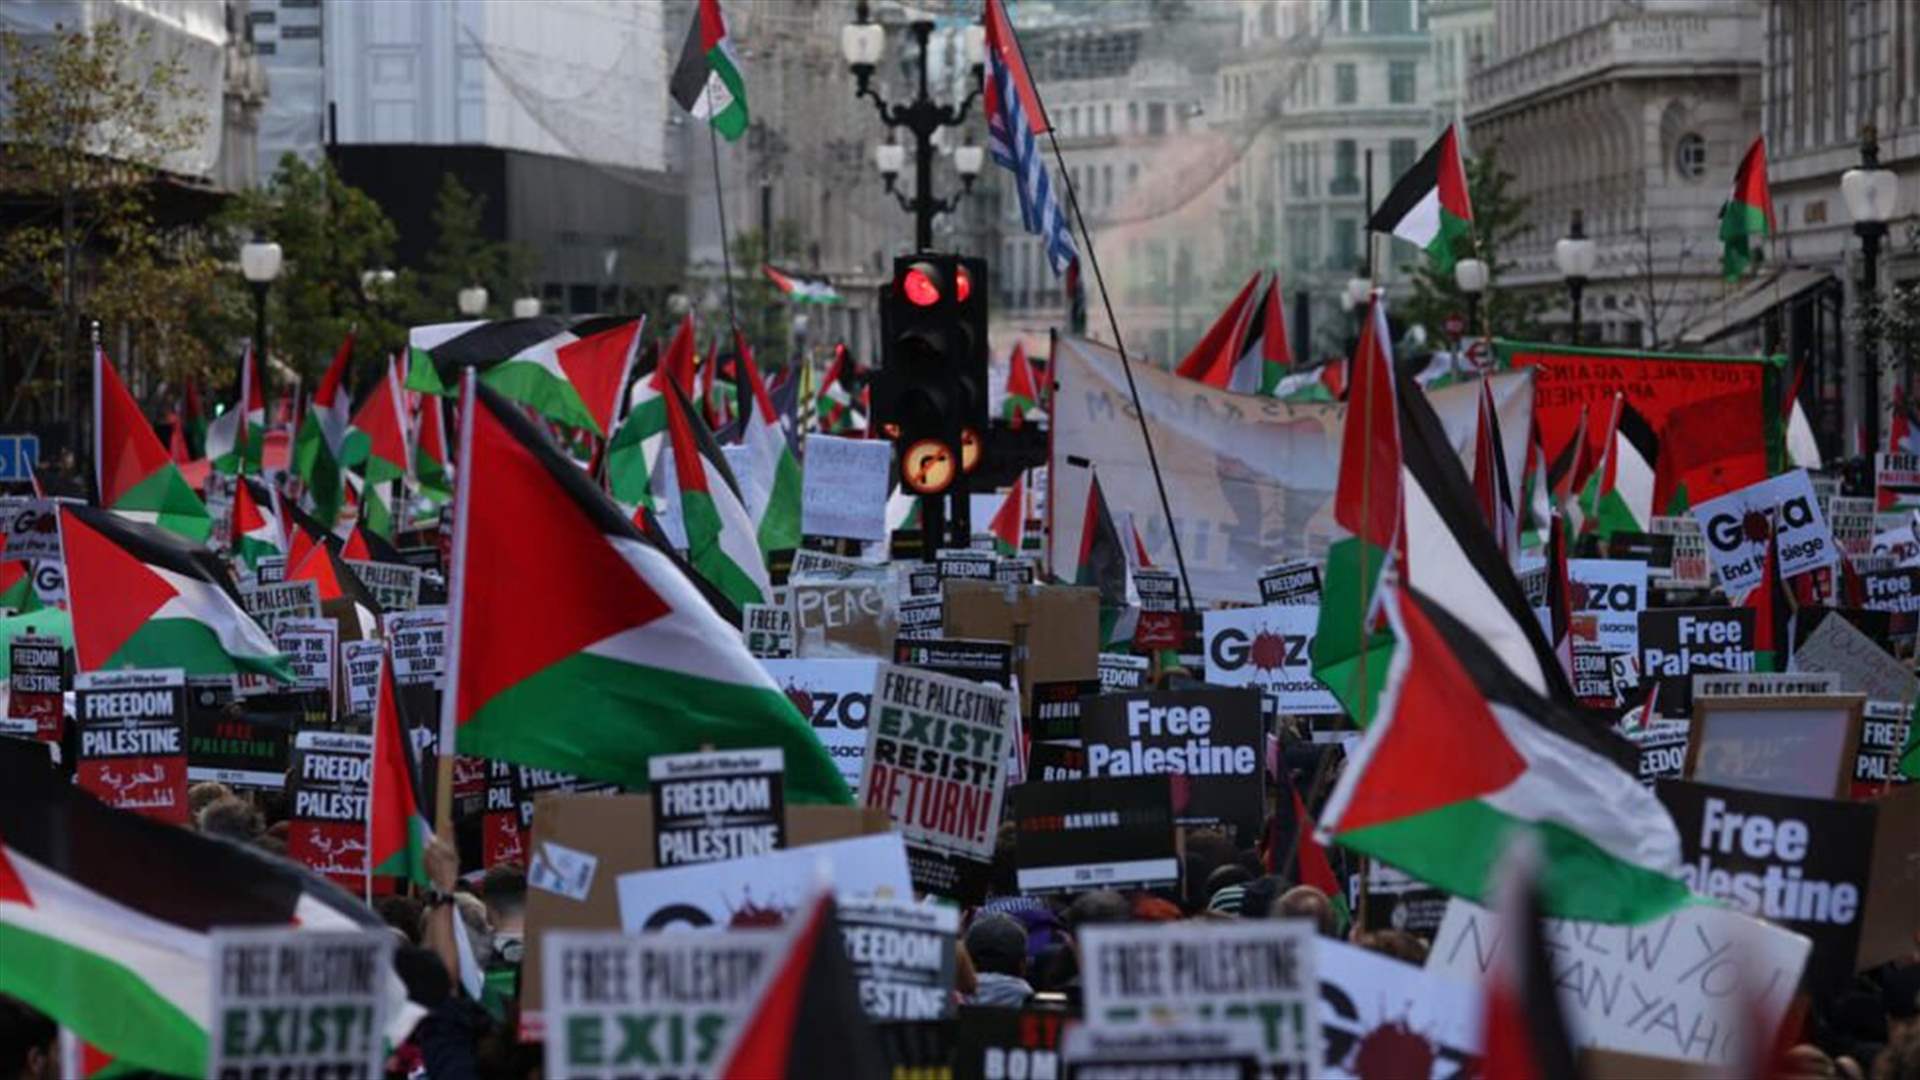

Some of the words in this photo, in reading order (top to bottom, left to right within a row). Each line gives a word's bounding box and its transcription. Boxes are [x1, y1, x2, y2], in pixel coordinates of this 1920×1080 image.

[1883, 454, 1919, 471] FREE
[1781, 537, 1824, 561] siege
[365, 564, 414, 584] PALESTINE
[942, 562, 991, 578] FREEDOM
[1722, 560, 1750, 580] End
[1750, 551, 1765, 574] th
[256, 584, 311, 610] PALESTINE
[1262, 570, 1314, 595] FREEDOM
[1866, 576, 1911, 595] Free
[797, 587, 883, 629] PEAC
[1583, 583, 1637, 612] za
[750, 609, 778, 630] FREE
[1678, 616, 1742, 644] Free
[305, 638, 324, 650] THE
[393, 633, 421, 647] STOP
[425, 631, 444, 645] THE
[14, 648, 59, 666] FREEDOM
[351, 660, 378, 675] STOP
[409, 658, 436, 671] WAR
[1574, 655, 1607, 672] EEDOM
[1644, 645, 1756, 676] Palestin
[883, 672, 925, 708] FREE
[924, 679, 1008, 728] PALESTINE
[1271, 681, 1328, 691] massa
[85, 690, 173, 718] FREEDOM
[808, 691, 873, 729] za
[1127, 700, 1211, 736] Free
[82, 727, 181, 756] PALESTINE
[877, 706, 1004, 761] EXIST!
[873, 738, 998, 789] RESIST!
[1087, 738, 1256, 778] Palestine
[662, 777, 769, 816] FREEDOM
[866, 763, 993, 844] RETURN!
[310, 828, 367, 855] حرية
[1701, 797, 1809, 862] Free
[659, 824, 778, 865] PALESTINE
[844, 927, 943, 970] EEDOM
[562, 947, 629, 1004] FREE
[1100, 943, 1163, 996] FREE
[1170, 938, 1300, 993] PALESTINE
[858, 980, 947, 1021] ESTINE
[1447, 915, 1739, 1062] NANYAH
[222, 1006, 376, 1057] EXIST!
[566, 1012, 728, 1066] EXIS
[1020, 1013, 1059, 1050] ST
